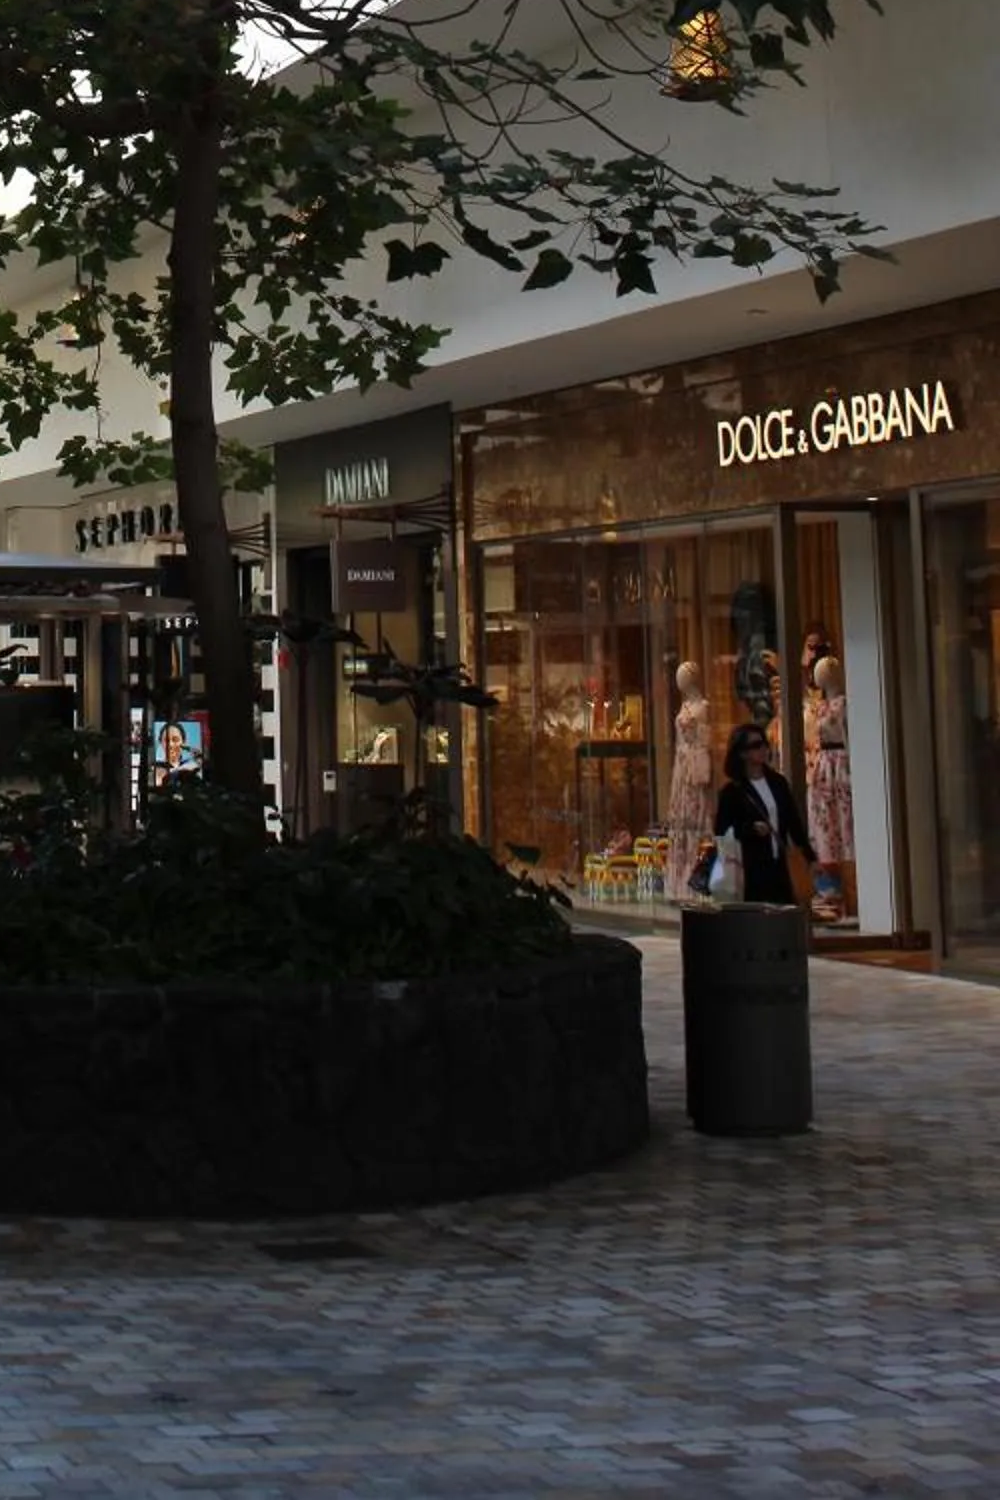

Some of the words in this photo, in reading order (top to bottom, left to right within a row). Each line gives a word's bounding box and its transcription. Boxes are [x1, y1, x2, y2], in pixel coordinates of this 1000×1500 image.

[717, 409, 795, 467] DOLCE
[797, 429, 809, 454] &
[811, 380, 955, 453] GABBANA
[325, 457, 390, 507] DAMIANI
[75, 503, 182, 553] SEPHOR
[346, 568, 396, 581] DAMIANI
